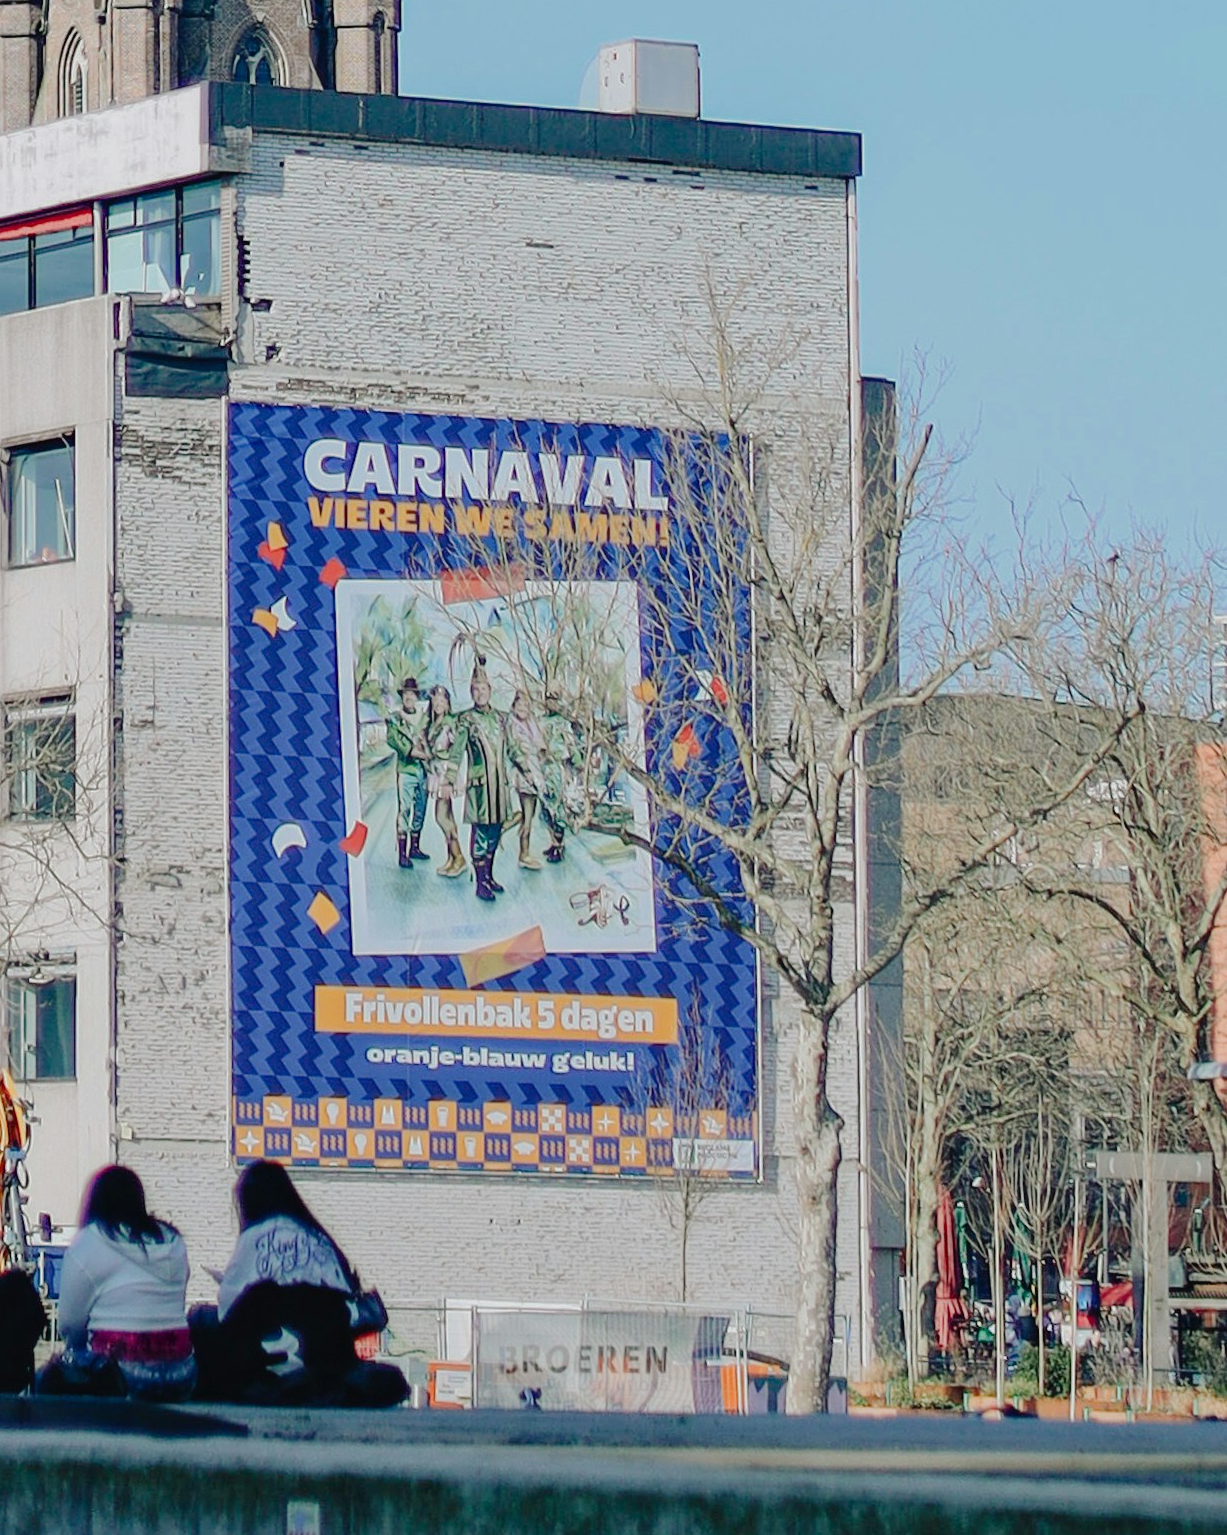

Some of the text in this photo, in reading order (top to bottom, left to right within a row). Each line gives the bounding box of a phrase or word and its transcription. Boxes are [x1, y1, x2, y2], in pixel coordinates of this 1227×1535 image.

[303, 438, 669, 511] CARNAVAL
[307, 497, 671, 548] VIEREN WE SAMEN!
[345, 992, 655, 1040] Frivollenbak 5 dagen
[366, 1045, 634, 1074] oranje-blauw geluk!
[499, 1344, 668, 1374] BROEREN
